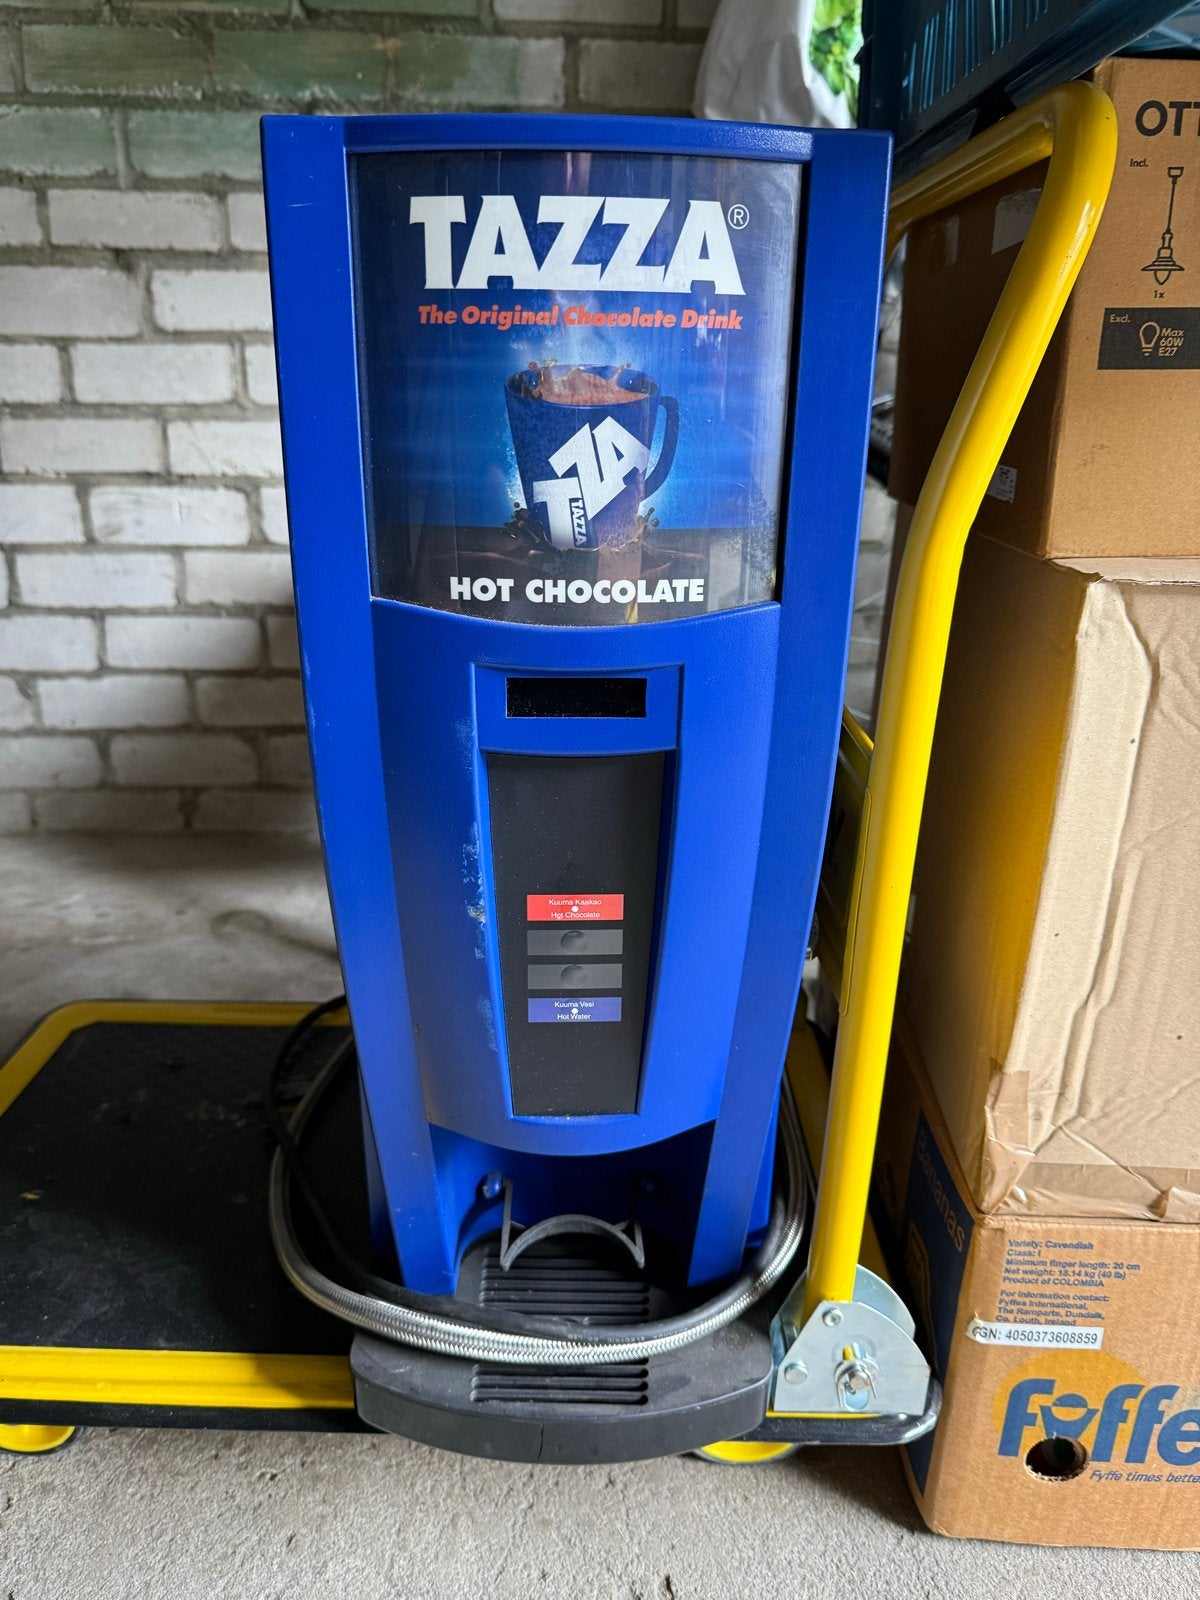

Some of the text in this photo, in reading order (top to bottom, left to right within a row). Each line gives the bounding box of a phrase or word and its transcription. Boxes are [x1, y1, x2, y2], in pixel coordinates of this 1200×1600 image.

[1129, 158, 1149, 168] Incl.
[1153, 290, 1165, 299] 1x
[418, 305, 743, 330] The Original Chocolate Drink
[1109, 314, 1131, 323] Excl.
[1161, 327, 1184, 337] Max
[1160, 337, 1184, 347] 60W
[1158, 347, 1178, 356] E27
[569, 498, 588, 546] TAZZA
[450, 576, 704, 604] HOT CHOCOLATE
[1008, 1239, 1094, 1250] Variety: Cavendish
[1007, 1249, 1035, 1257] Class:
[1005, 1258, 1047, 1267] Minimum
[1049, 1259, 1076, 1269] finger
[1078, 1261, 1110, 1271] length:
[1113, 1262, 1124, 1270] 20
[1004, 1267, 1020, 1275] Net
[1022, 1268, 1056, 1277] weight:
[1084, 1270, 1095, 1279] kg
[1113, 1271, 1126, 1280] lb)
[1003, 1276, 1104, 1287] Product of COLOMBIA
[1000, 1289, 1016, 1297] For
[1018, 1290, 1070, 1300] information
[999, 1298, 1027, 1306] Fyffes
[998, 1306, 1014, 1314] The
[1044, 1318, 1076, 1326] Ireland
[1006, 1329, 1098, 1344] 4050373608859
[1090, 1470, 1123, 1482] Fyffe
[1126, 1471, 1163, 1482] times
